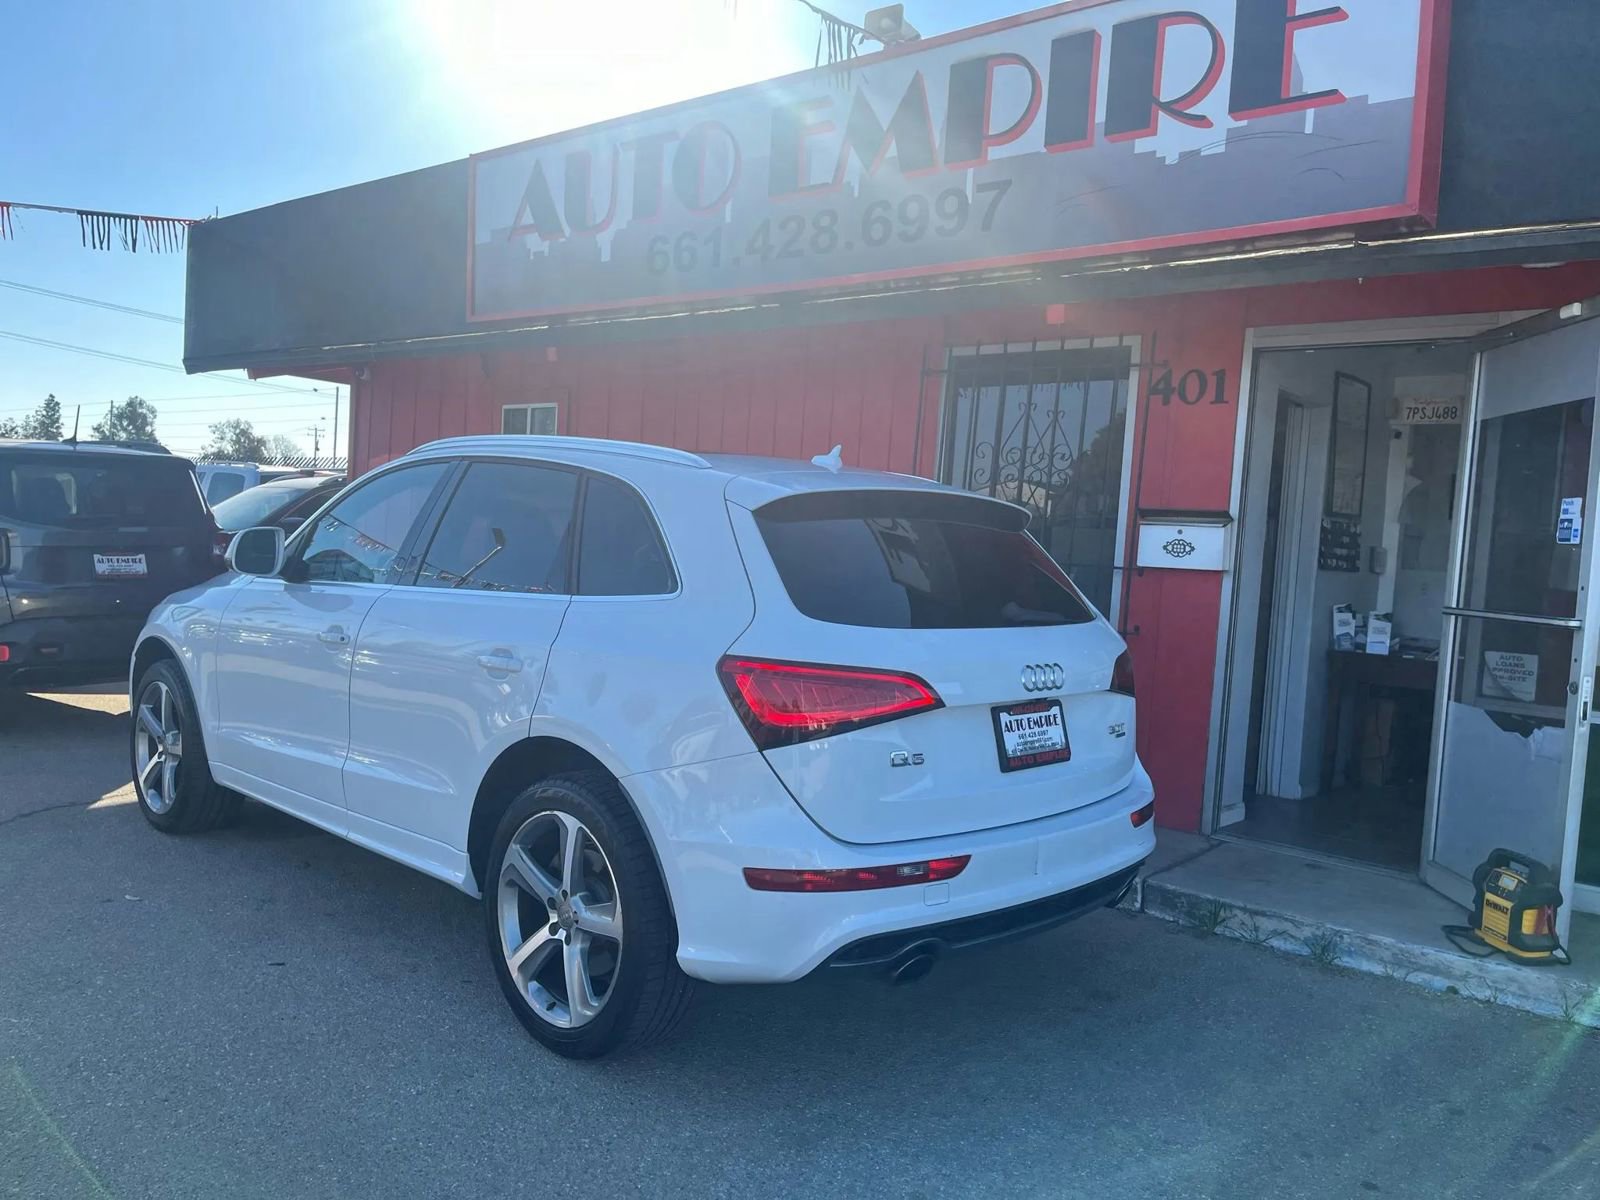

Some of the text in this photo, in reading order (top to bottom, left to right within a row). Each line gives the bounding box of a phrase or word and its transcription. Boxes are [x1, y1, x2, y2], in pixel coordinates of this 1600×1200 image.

[508, 0, 1350, 242] AUTO EMPIRE
[646, 178, 1014, 277] 661.428.6997
[1149, 368, 1230, 407] 401
[1406, 406, 1458, 420] 7PSJ488
[1496, 660, 1525, 668] LOANS
[1003, 713, 1060, 733] AUTO EMPIRE
[890, 751, 925, 768] Q5
